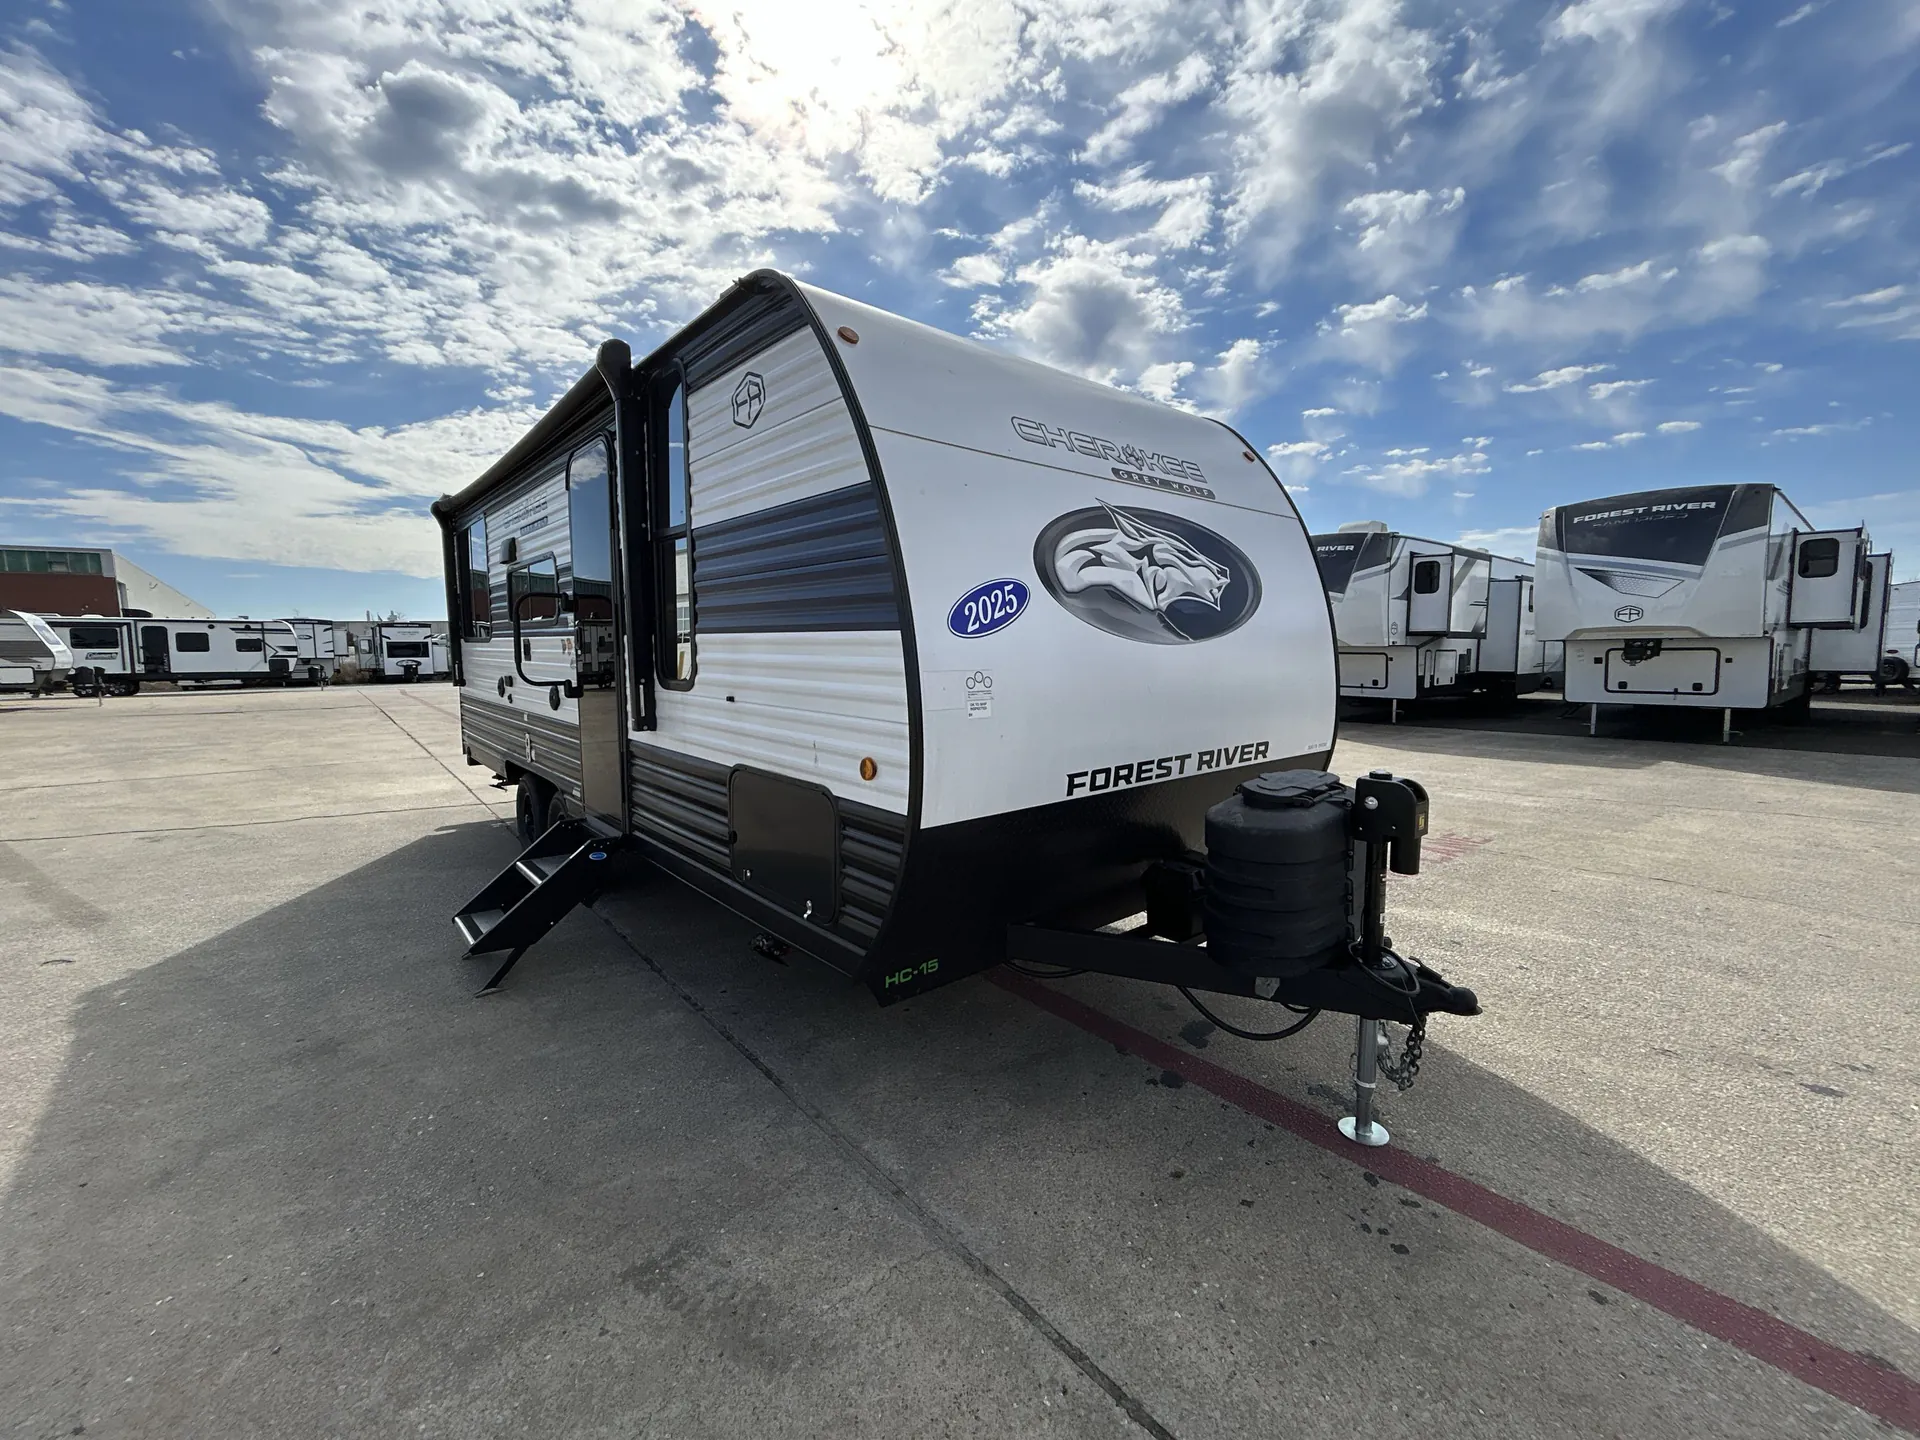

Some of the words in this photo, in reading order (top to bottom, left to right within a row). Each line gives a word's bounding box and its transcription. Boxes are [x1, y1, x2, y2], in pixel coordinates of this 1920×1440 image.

[1119, 470, 1161, 486] GREY
[1169, 481, 1209, 496] WOLF
[1573, 506, 1648, 524] FOREST
[1652, 501, 1716, 512] RIVER
[964, 583, 1018, 633] 2025
[1066, 752, 1192, 797] FOREST
[1197, 740, 1270, 772] RIVER
[885, 958, 939, 989] HC-15
